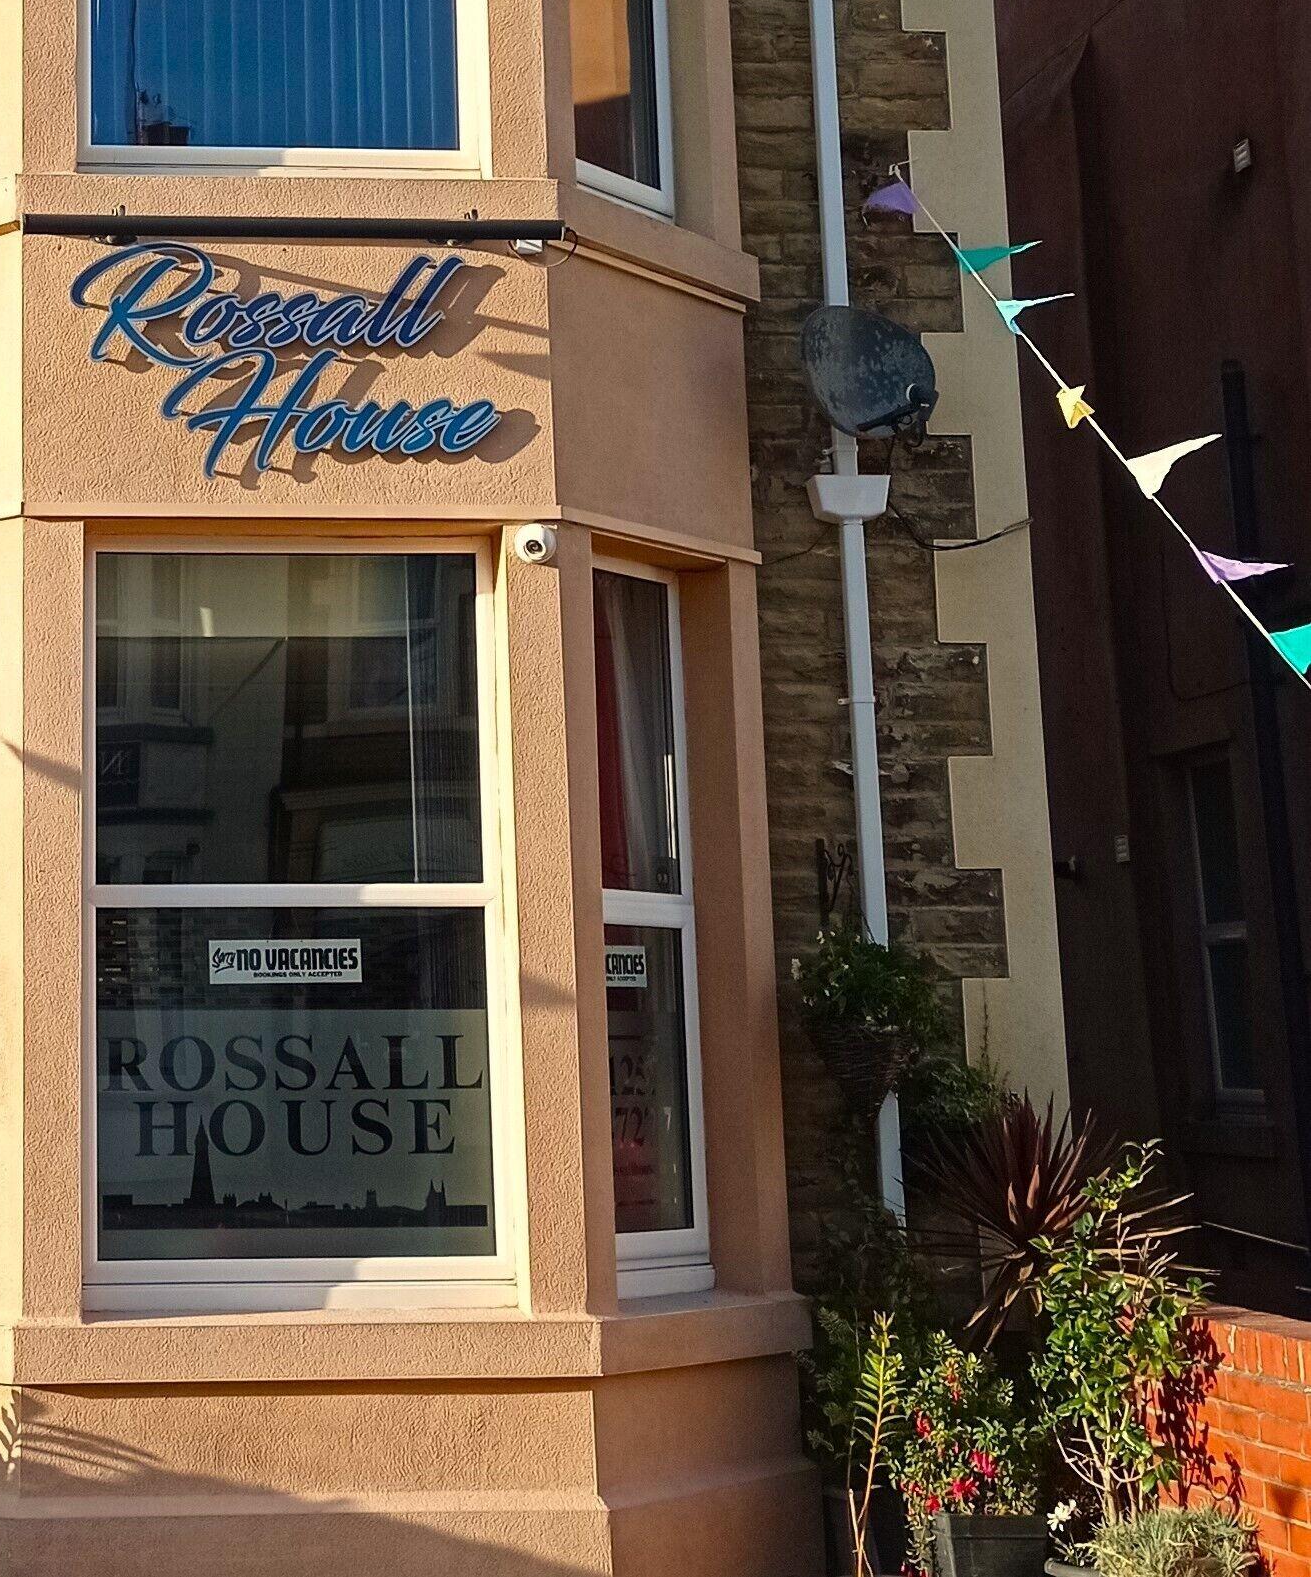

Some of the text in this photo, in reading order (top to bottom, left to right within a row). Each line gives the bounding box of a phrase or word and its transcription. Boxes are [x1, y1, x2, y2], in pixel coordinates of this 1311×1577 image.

[70, 241, 466, 369] Rossall
[160, 348, 502, 479] House
[236, 948, 261, 971] NO
[265, 947, 359, 971] VACANCIES
[253, 971, 288, 979] BOOKINGS
[308, 970, 343, 978] ACCEPTED
[103, 1034, 483, 1093] ROSSALL
[133, 1098, 456, 1157] HOUSE
